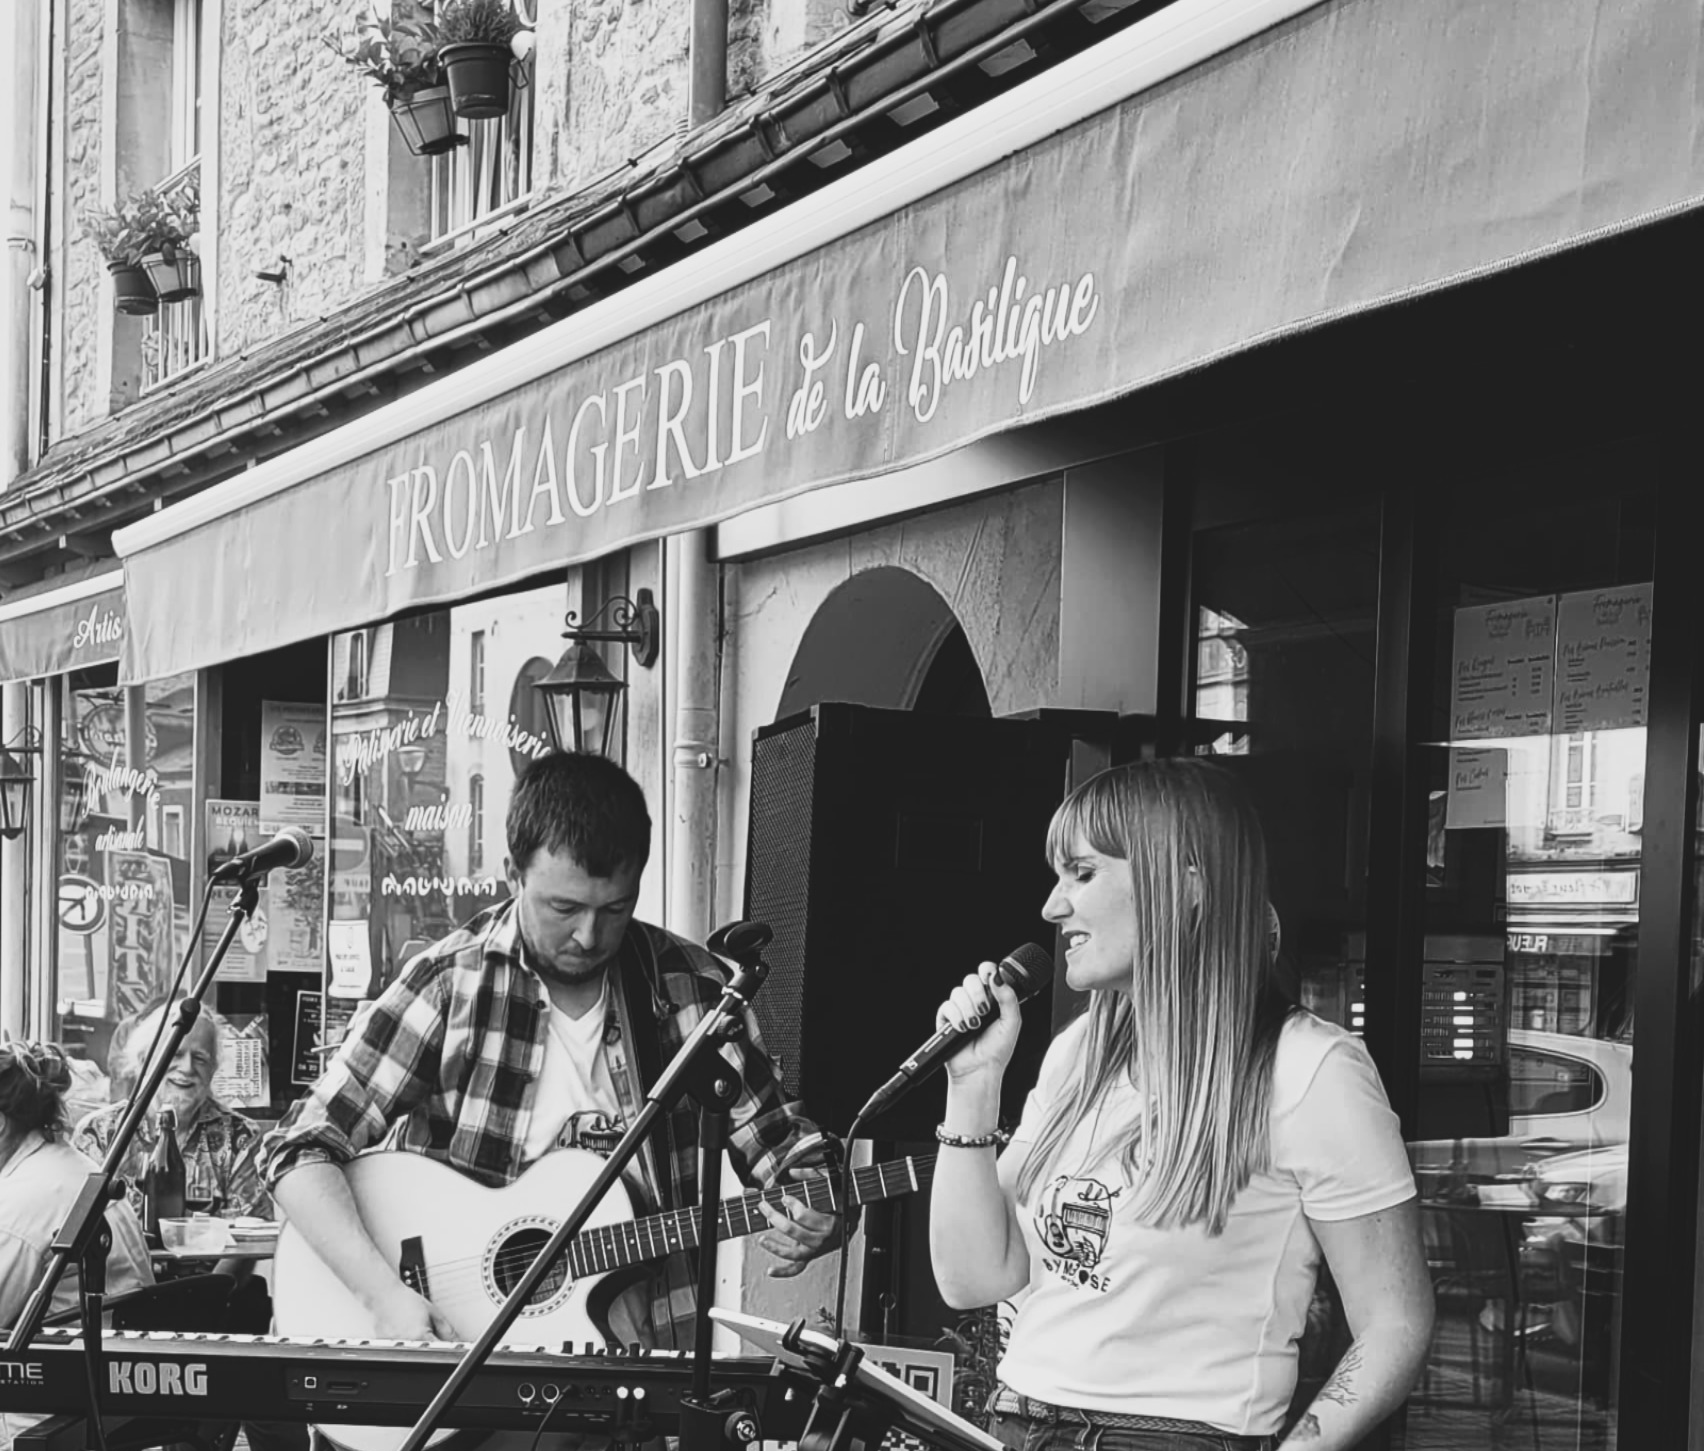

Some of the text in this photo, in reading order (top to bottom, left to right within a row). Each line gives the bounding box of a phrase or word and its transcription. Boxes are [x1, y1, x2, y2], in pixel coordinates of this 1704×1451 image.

[383, 255, 1099, 578] FROMAGERIE de la Basilique
[73, 604, 123, 649] Artis
[421, 701, 441, 737] et
[212, 805, 259, 817] MOZAR
[404, 793, 474, 832] maison
[108, 1361, 208, 1396] KORG
